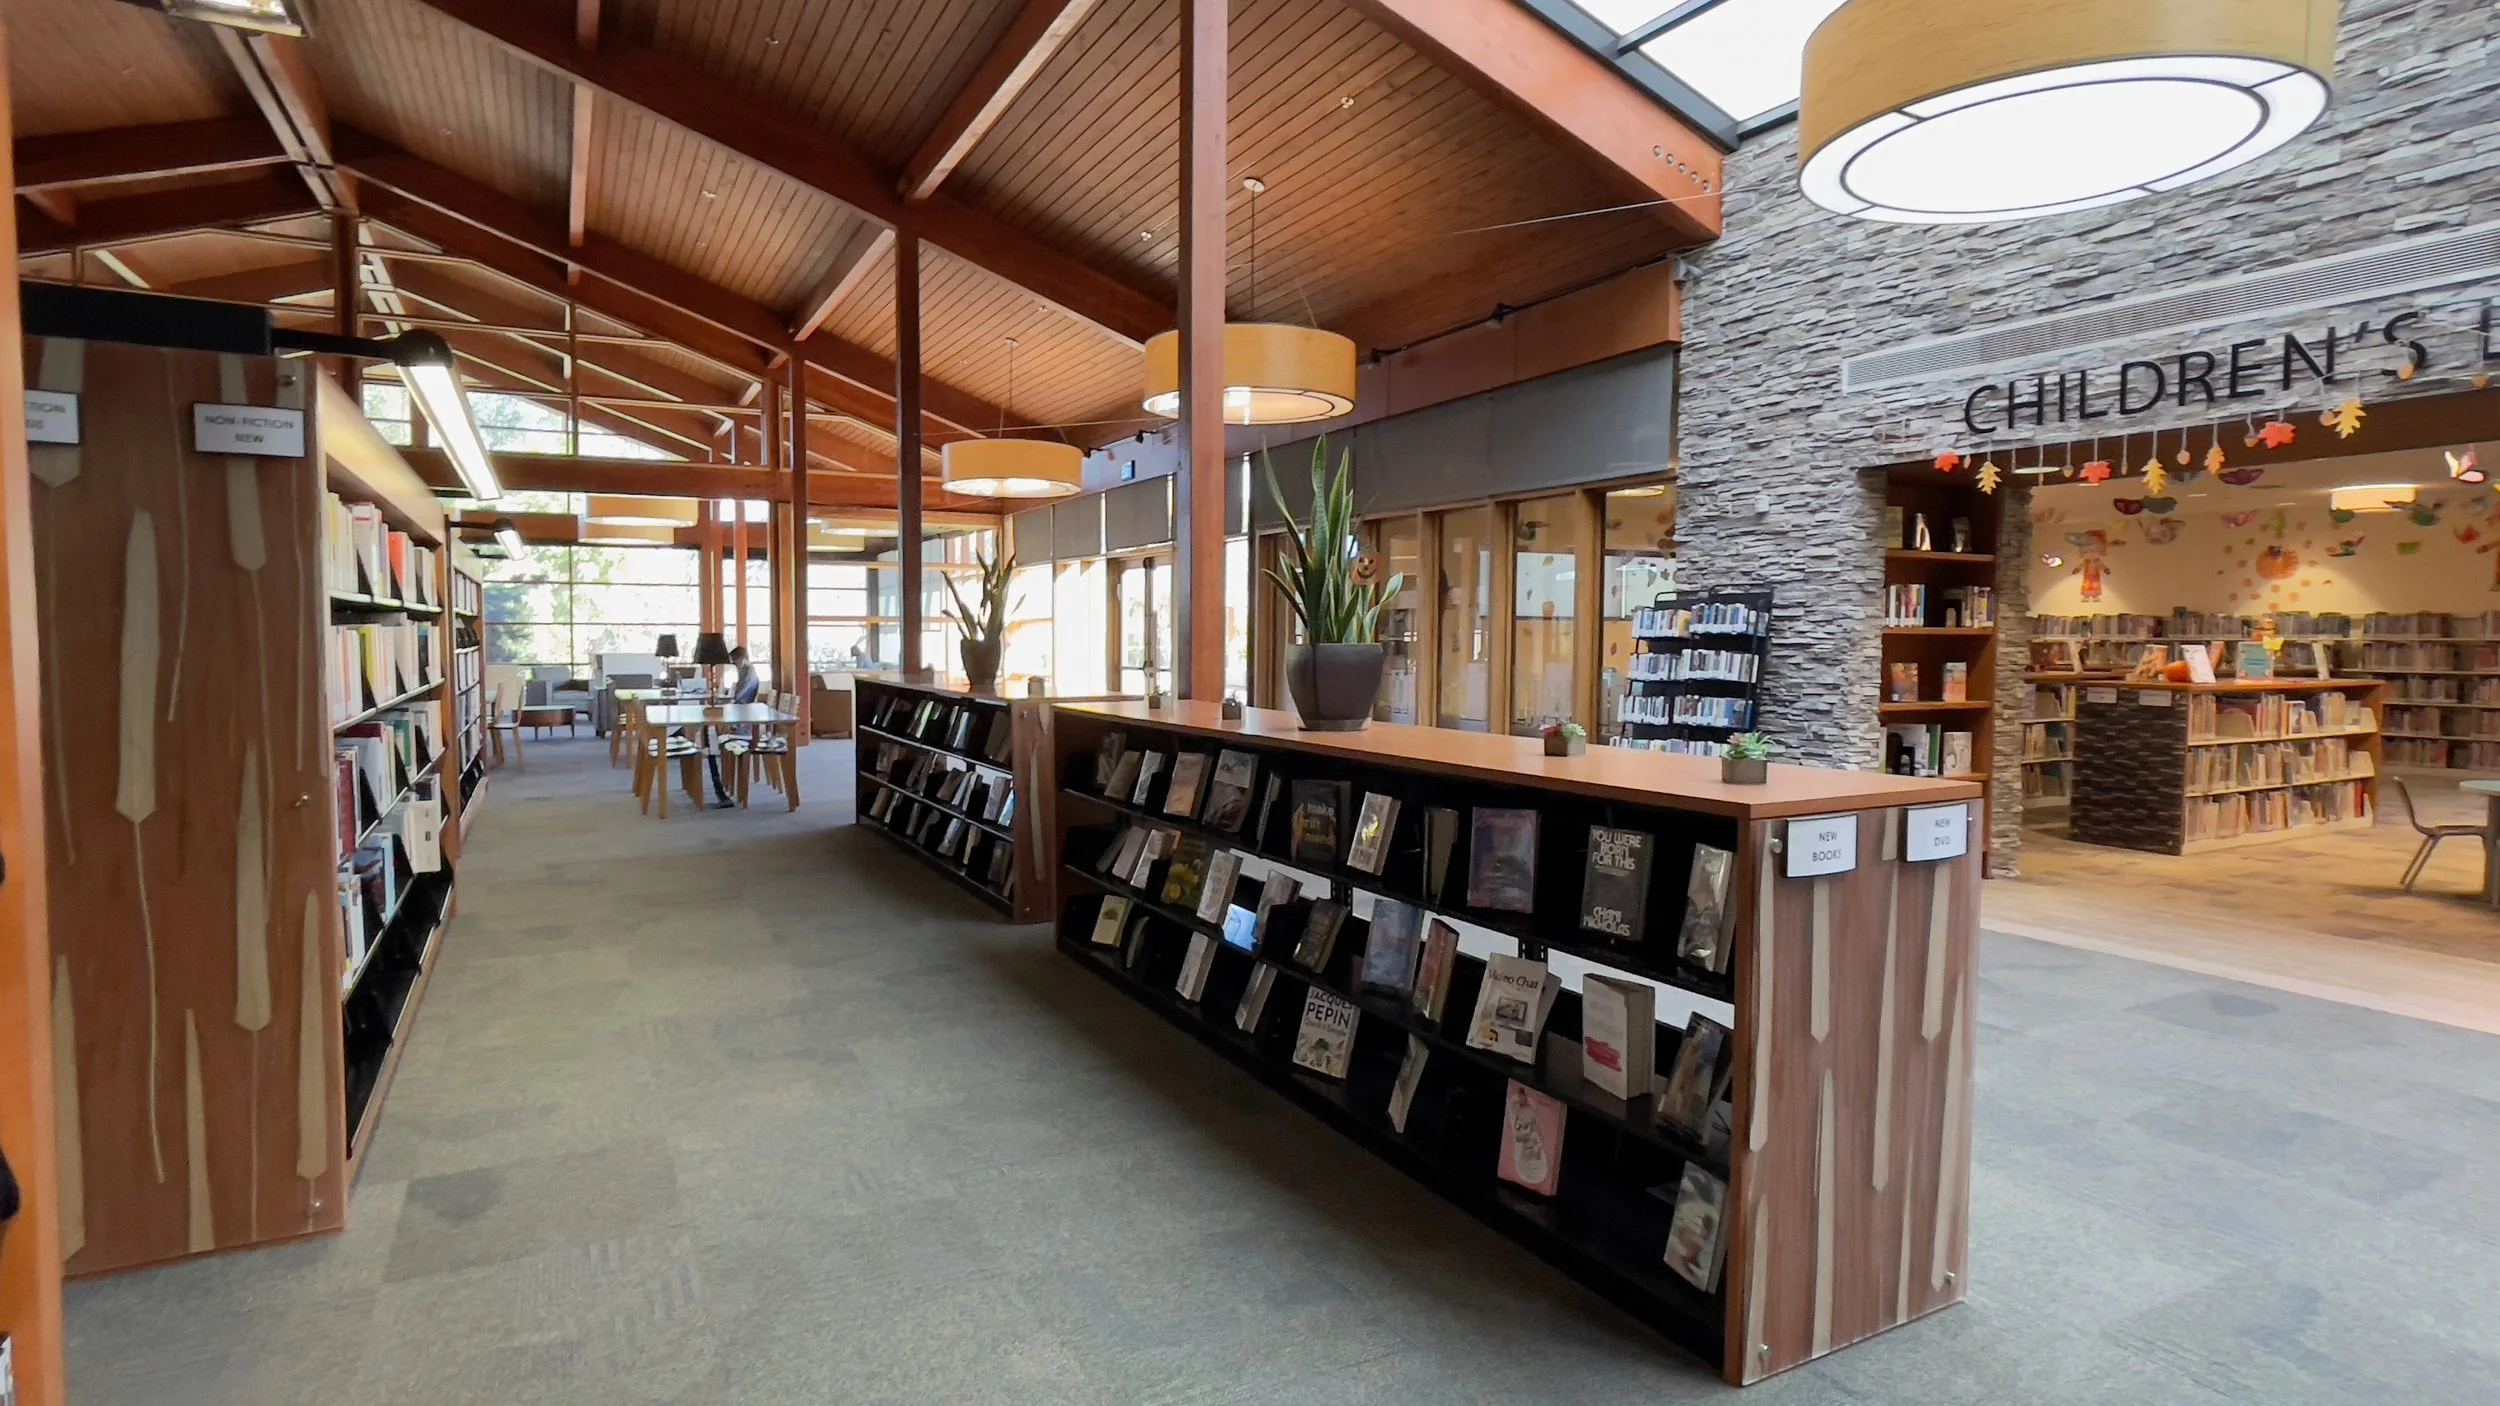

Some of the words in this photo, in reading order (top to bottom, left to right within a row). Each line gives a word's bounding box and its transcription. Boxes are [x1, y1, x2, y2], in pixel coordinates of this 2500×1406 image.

[1963, 310, 2430, 434] CHILDREN'S
[204, 415, 294, 430] NON-FICTION
[234, 433, 265, 445] NEW
[1934, 818, 1951, 829] NEW
[1592, 829, 1612, 843] YOU
[1613, 831, 1643, 848] WERE
[1818, 831, 1837, 843] NEW
[1934, 836, 1951, 848] DVD
[1600, 842, 1630, 857] BORN
[1812, 849, 1842, 863] BOOKS
[1592, 852, 1613, 866] FOR
[1615, 855, 1636, 870] THIS
[1516, 975, 1539, 989] Chat
[1306, 1001, 1351, 1029] PEPIN
